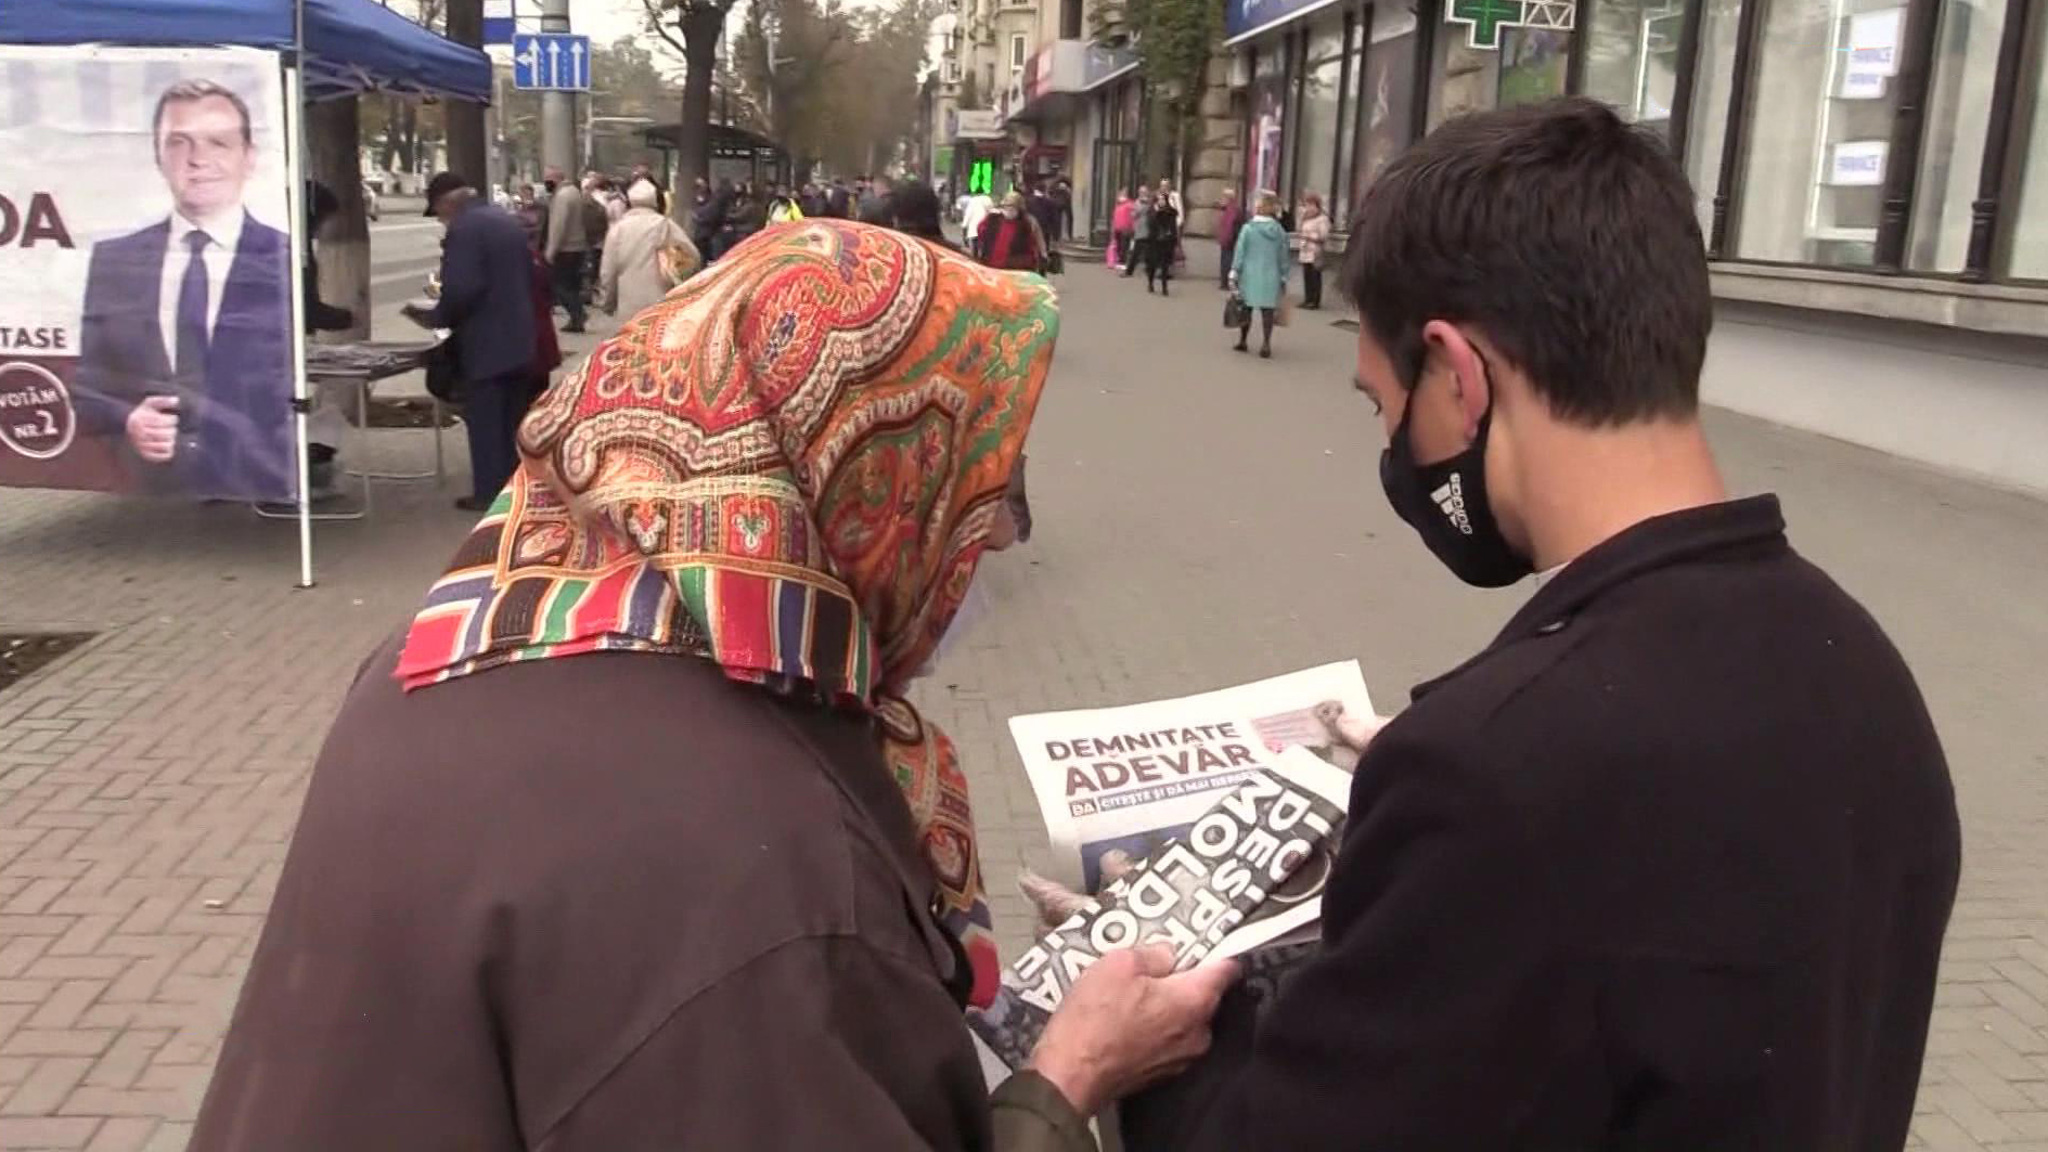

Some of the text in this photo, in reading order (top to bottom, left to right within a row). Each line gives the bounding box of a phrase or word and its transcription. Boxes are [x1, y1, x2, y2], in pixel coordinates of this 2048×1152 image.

[0, 327, 68, 349] TASE
[1045, 722, 1242, 762] DEMNITATE
[1066, 743, 1258, 796] ADEVĂR
[1019, 770, 1283, 1013] MOLDOVA
[1145, 789, 1312, 958] DESPR
